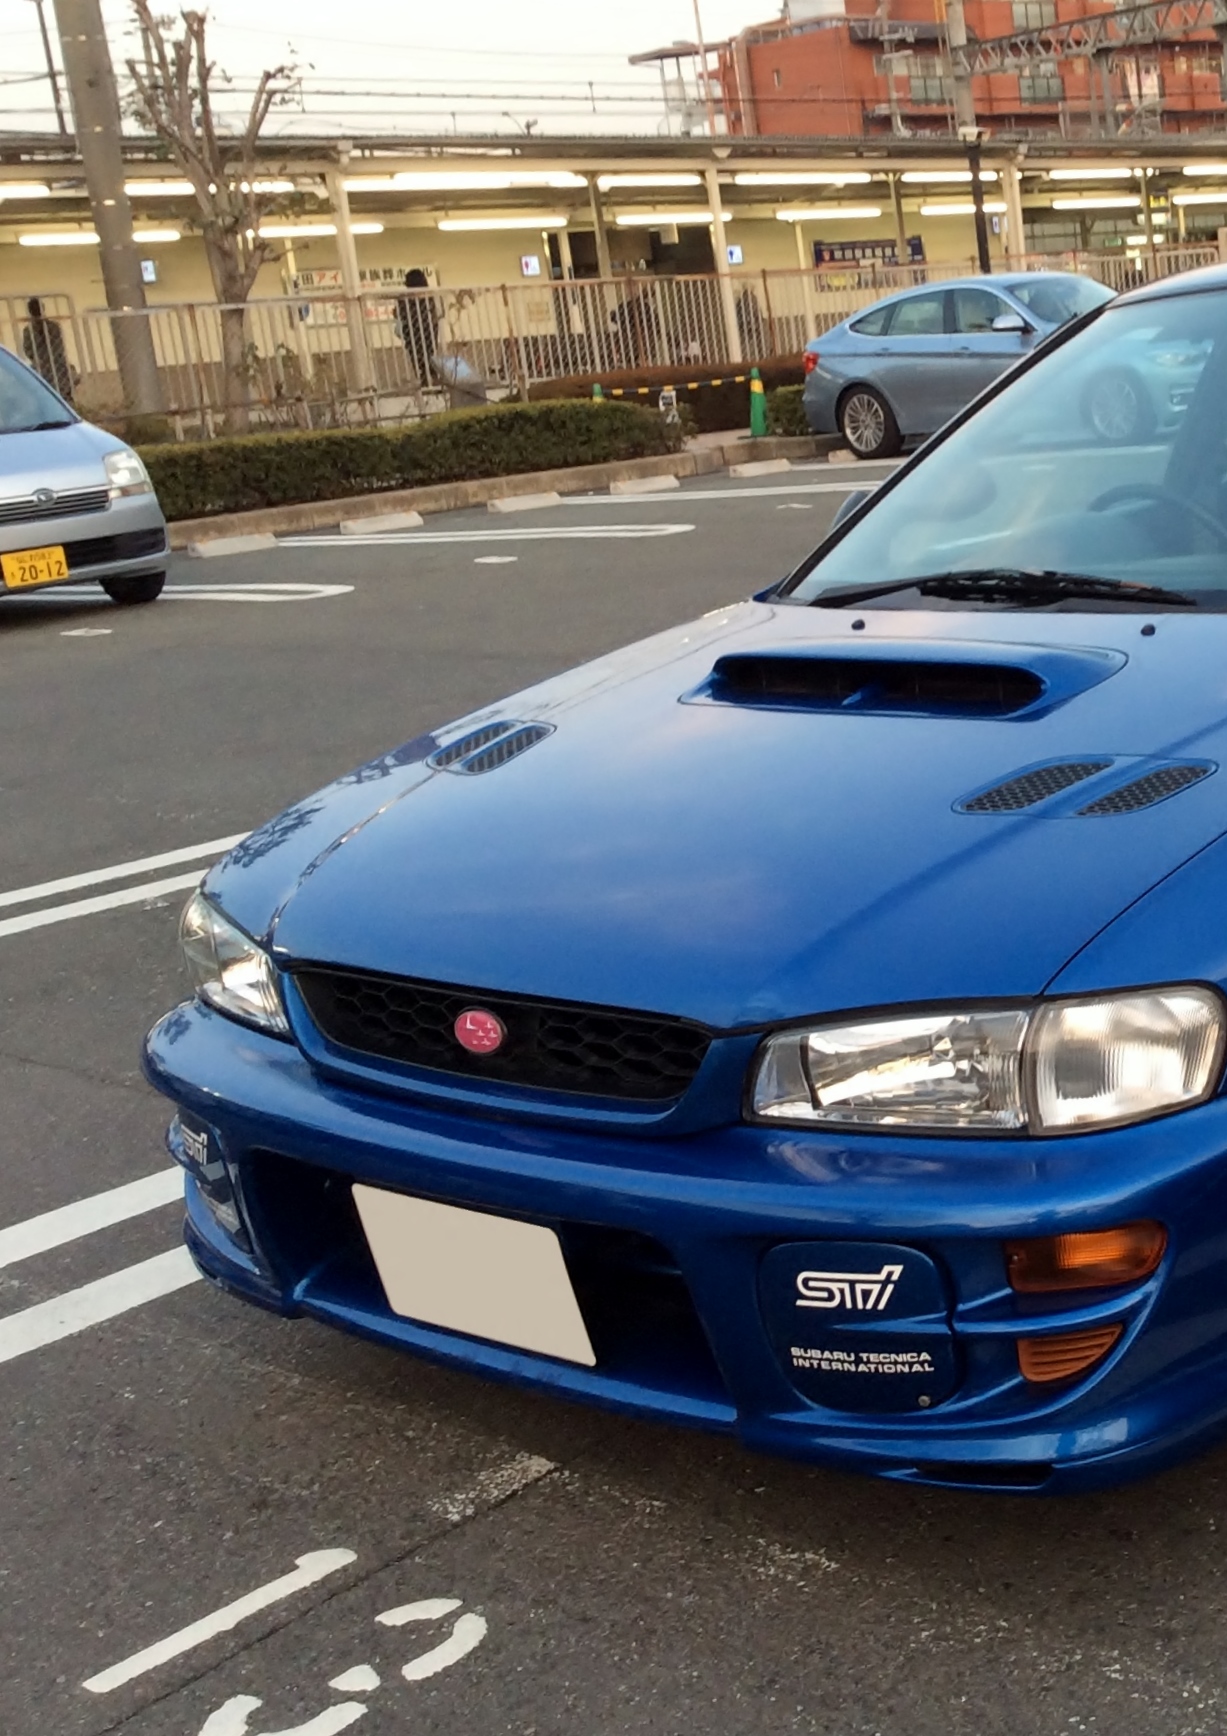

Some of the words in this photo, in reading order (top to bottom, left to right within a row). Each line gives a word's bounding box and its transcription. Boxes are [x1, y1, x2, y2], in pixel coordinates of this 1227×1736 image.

[19, 560, 65, 582] 20-12
[790, 1347, 855, 1361] SUBARU
[859, 1352, 932, 1363] TECNICA
[793, 1358, 935, 1373] INTERNATIONAL
